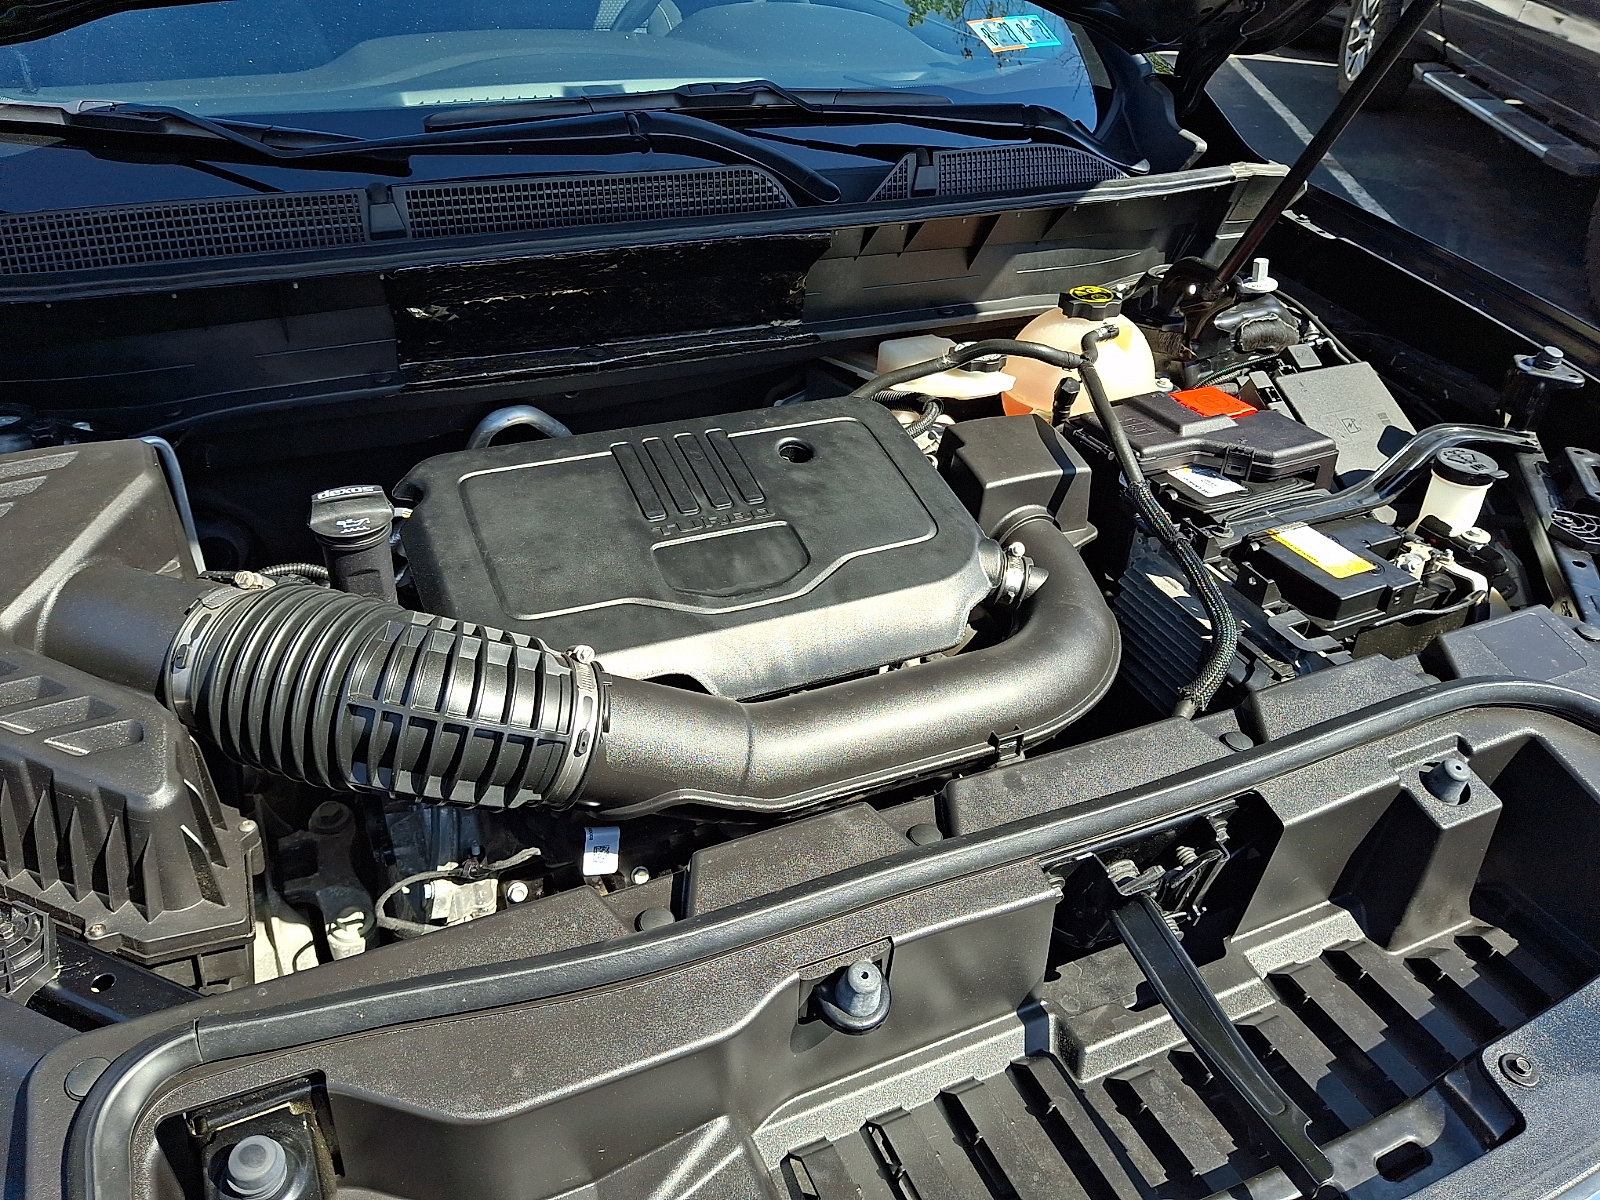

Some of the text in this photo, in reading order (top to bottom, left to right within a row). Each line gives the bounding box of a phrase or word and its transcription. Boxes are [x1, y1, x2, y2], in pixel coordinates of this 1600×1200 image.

[980, 28, 998, 46] 8
[1015, 23, 1033, 42] 8
[317, 486, 375, 500] dexos
[651, 507, 776, 536] TURBO
